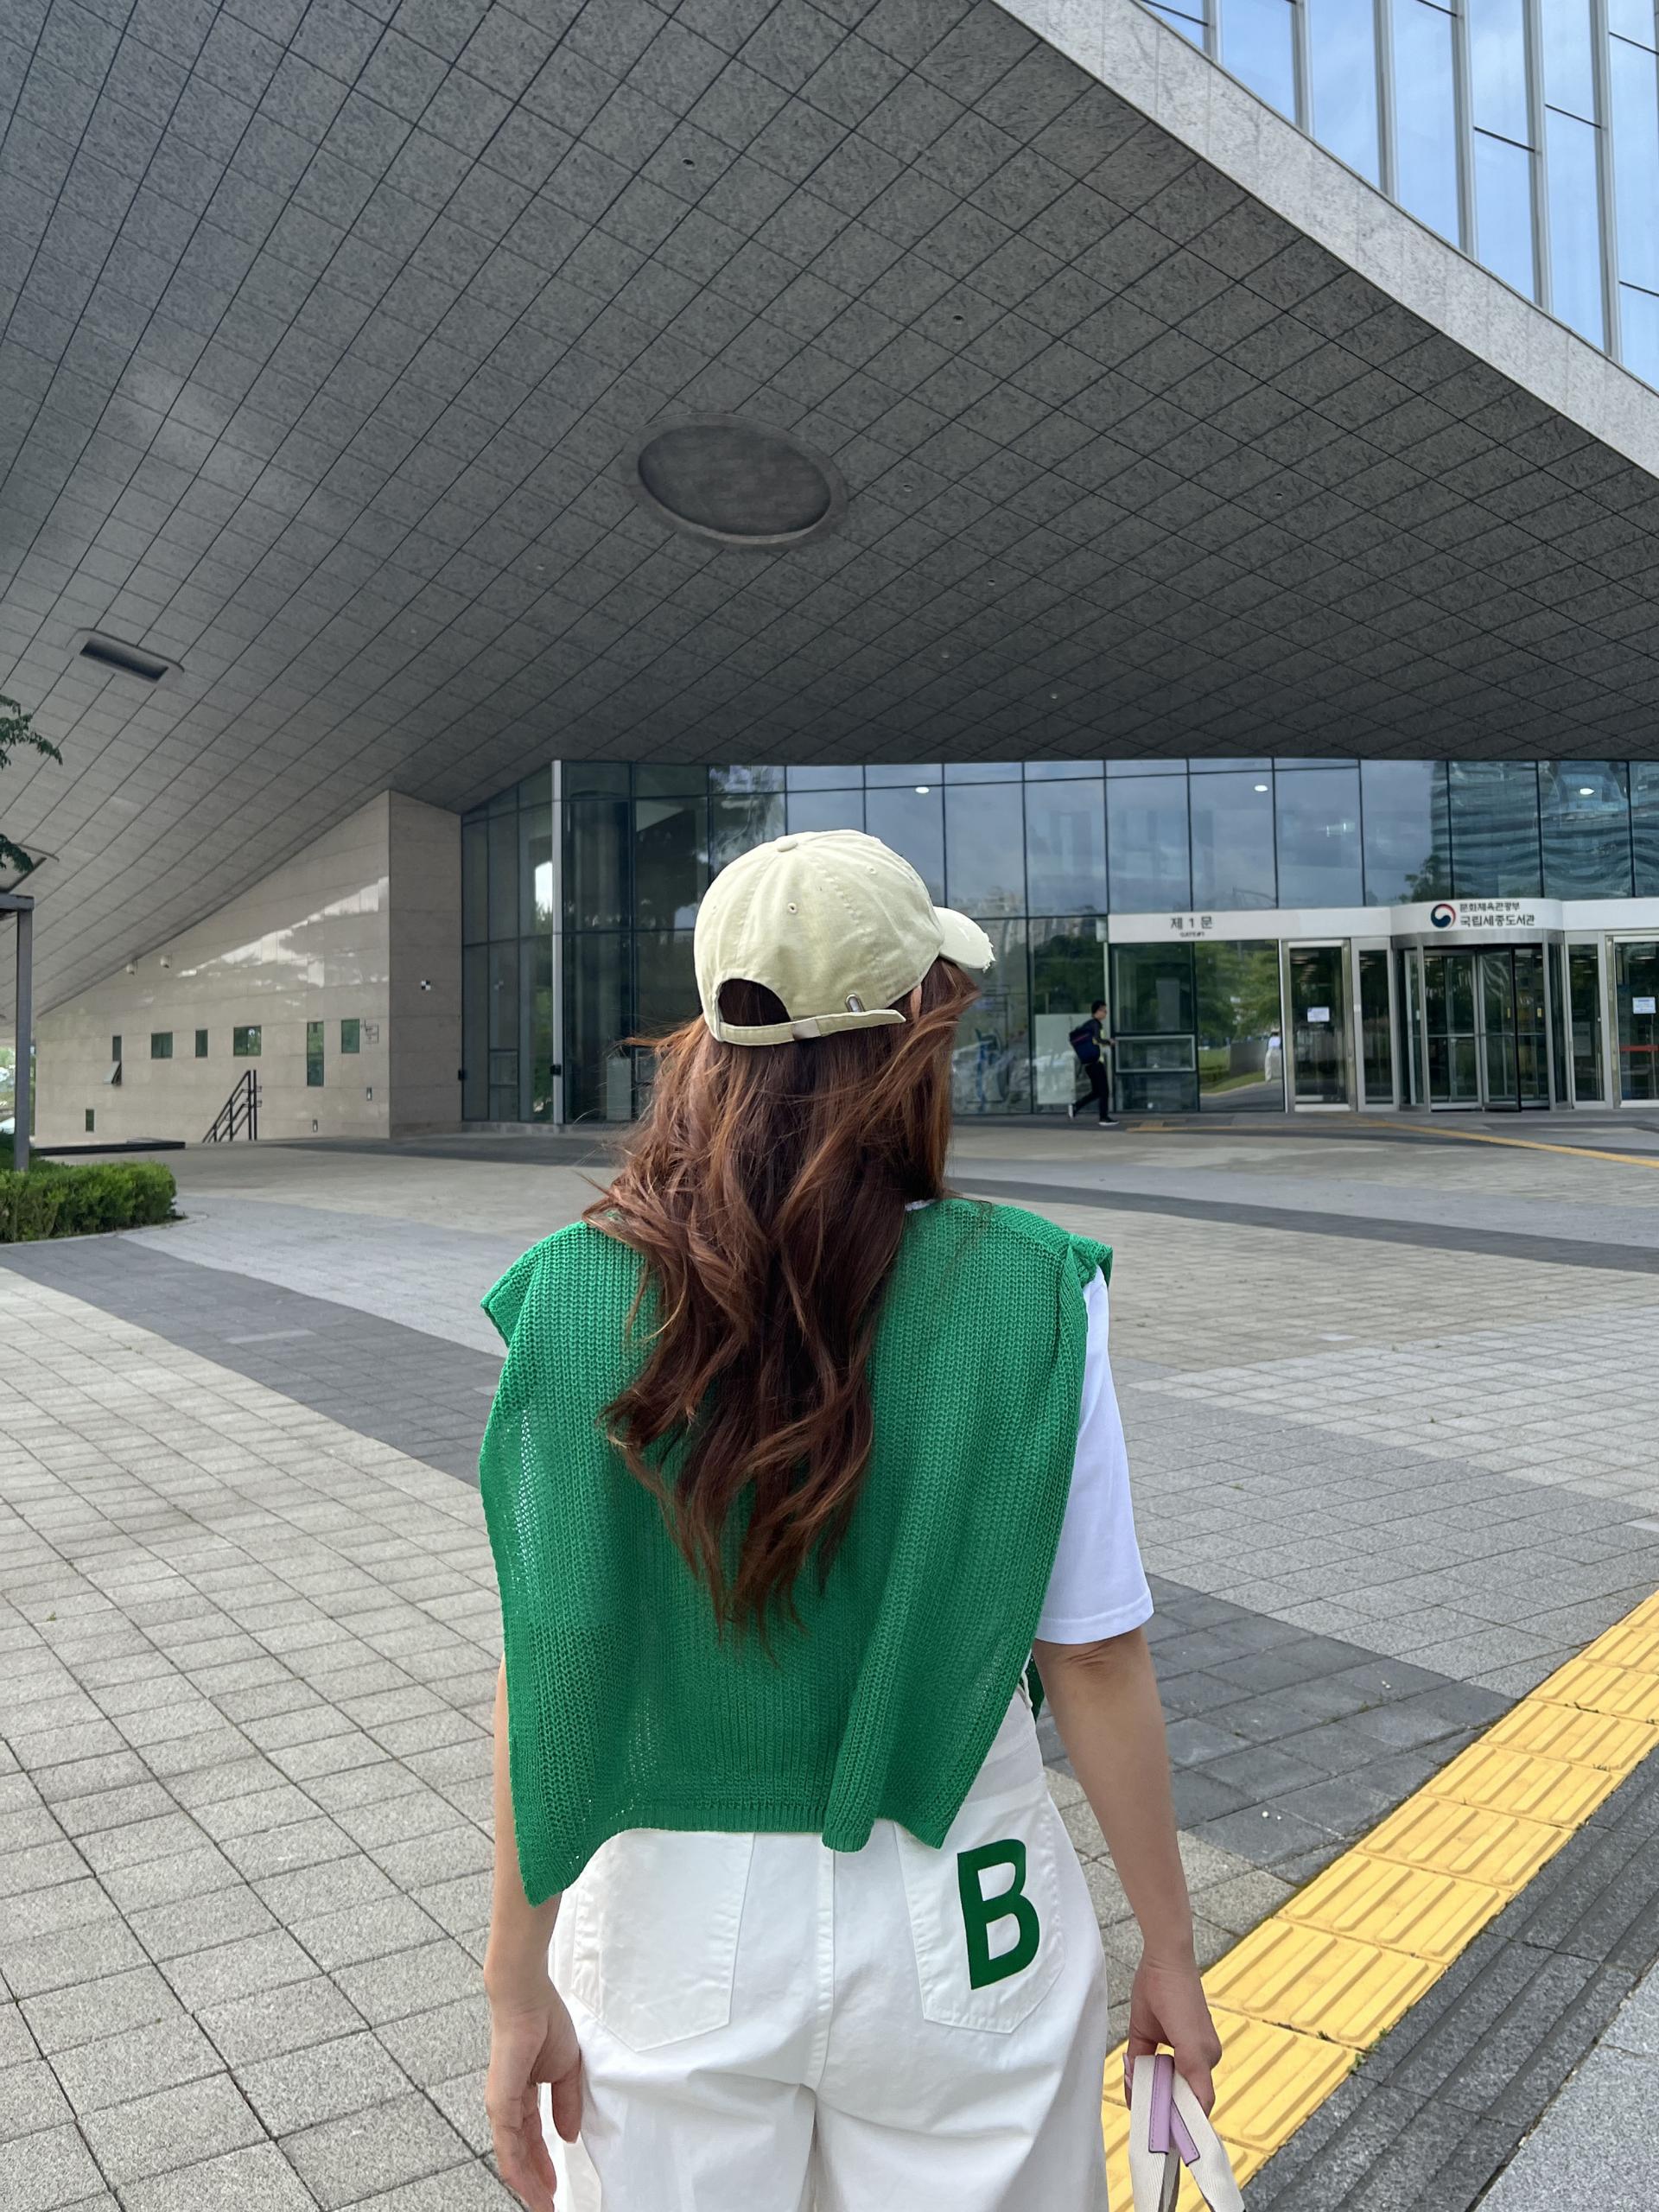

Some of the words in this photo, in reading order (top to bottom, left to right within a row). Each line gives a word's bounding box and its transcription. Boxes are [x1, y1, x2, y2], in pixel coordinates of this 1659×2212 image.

[1459, 902, 1520, 912] 문화체육관광부
[1460, 914, 1535, 927] 국립세종도서관
[957, 1839, 1039, 1990] B
